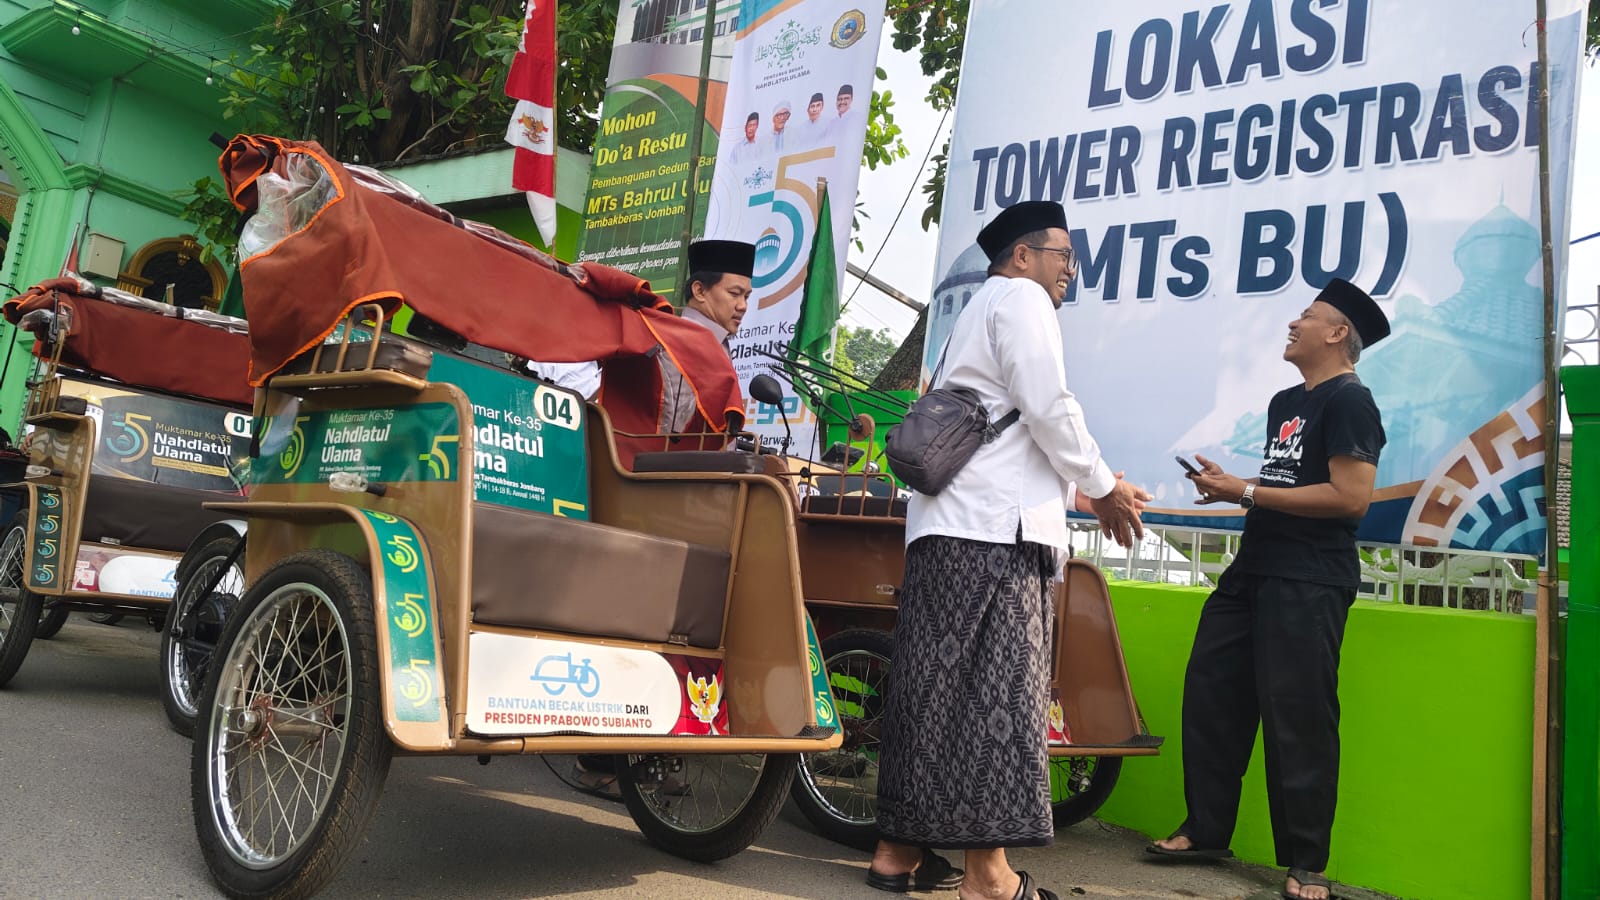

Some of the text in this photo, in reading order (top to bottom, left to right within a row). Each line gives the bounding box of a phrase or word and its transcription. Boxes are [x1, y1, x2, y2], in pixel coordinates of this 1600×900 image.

[1088, 0, 1371, 109] LOKASI
[602, 110, 657, 136] Mohon
[973, 61, 1540, 211] TOWER REGISTRASI
[596, 132, 688, 167] Do'a Restu
[592, 156, 717, 190] Pembangunan Gedun Bar
[587, 195, 618, 215] MTs
[622, 181, 677, 209] Bahrul
[584, 212, 643, 230] Tambakberas
[1236, 191, 1409, 297] BU)
[730, 340, 773, 361] dlatul
[329, 409, 395, 425] Muktamar Ke-35
[542, 392, 574, 425] 04
[155, 422, 202, 438] Muktamar
[503, 409, 543, 432] Ke-35
[154, 432, 232, 456] Nahdlatul
[324, 424, 392, 445] Nahdlatul
[473, 423, 545, 459] dlatul
[153, 443, 203, 463] Ulama
[321, 446, 362, 463] Ulama
[474, 450, 507, 474] ma
[128, 588, 172, 598] BANTUAN
[488, 697, 649, 715] BANTUAN BECAK LISTRIK DARI
[485, 712, 653, 728] PRESIDEN PRABOWO SUBIANTO
